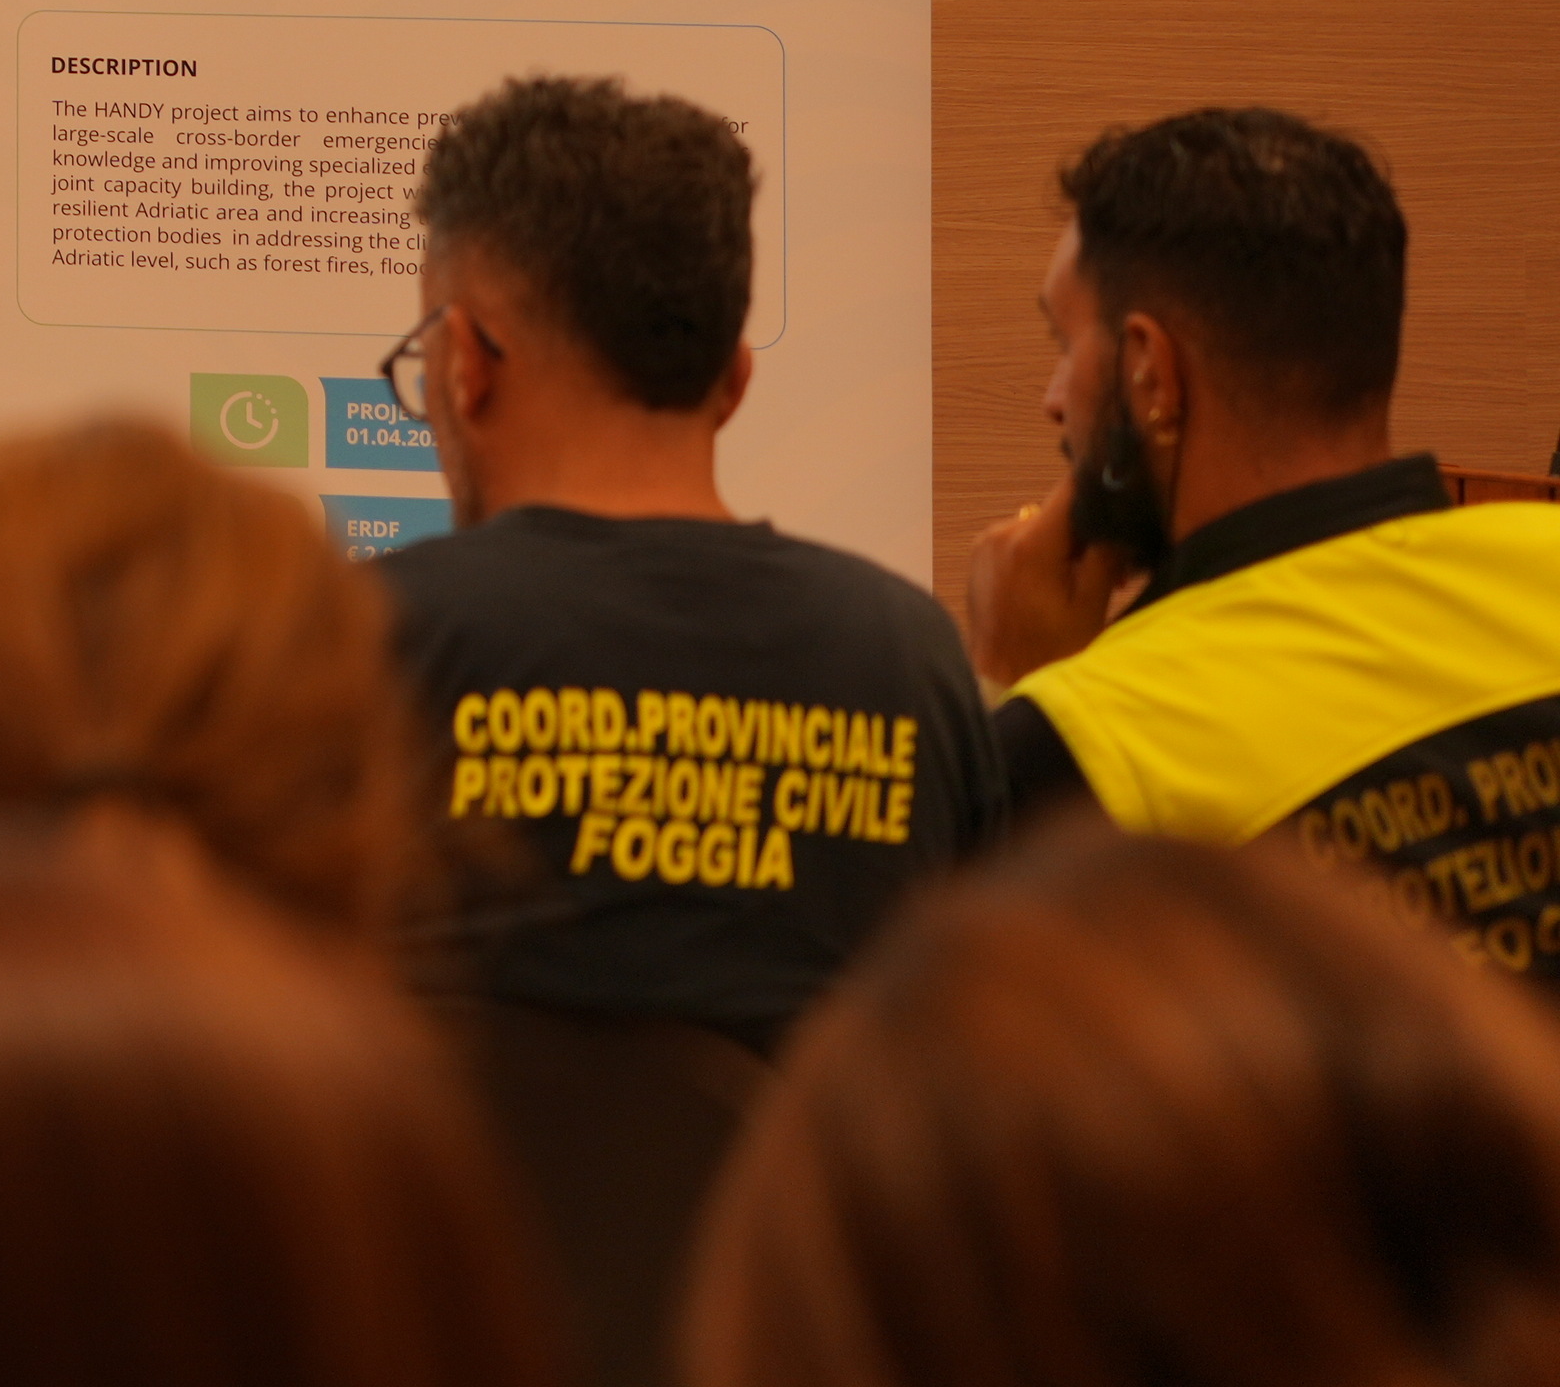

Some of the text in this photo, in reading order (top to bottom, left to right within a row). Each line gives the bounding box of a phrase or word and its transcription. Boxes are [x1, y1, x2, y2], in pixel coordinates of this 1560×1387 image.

[51, 56, 198, 79] DESCRIPTION
[52, 100, 410, 125] The HANDY project aims to enhance
[52, 125, 440, 153] large-scale cross-border emergencie
[52, 150, 156, 171] knowledge
[161, 153, 199, 171] and
[204, 154, 304, 177] improving
[309, 157, 416, 177] specialized
[50, 175, 95, 196] joint
[103, 178, 182, 199] capacity
[191, 178, 275, 201] building,
[283, 181, 316, 199] the
[325, 183, 394, 205] project
[52, 200, 129, 218] resilient
[135, 202, 210, 220] Adriatic
[216, 206, 259, 222] area
[266, 206, 304, 224] and
[310, 207, 411, 230] increasing
[52, 226, 401, 254] protection bodies in addressing the
[52, 248, 375, 276] Adriatic level, such as forest fires,
[347, 520, 400, 538] ERDF
[449, 754, 914, 845] PROTEZIONE CIVILE
[570, 812, 795, 891] FOGGIA
